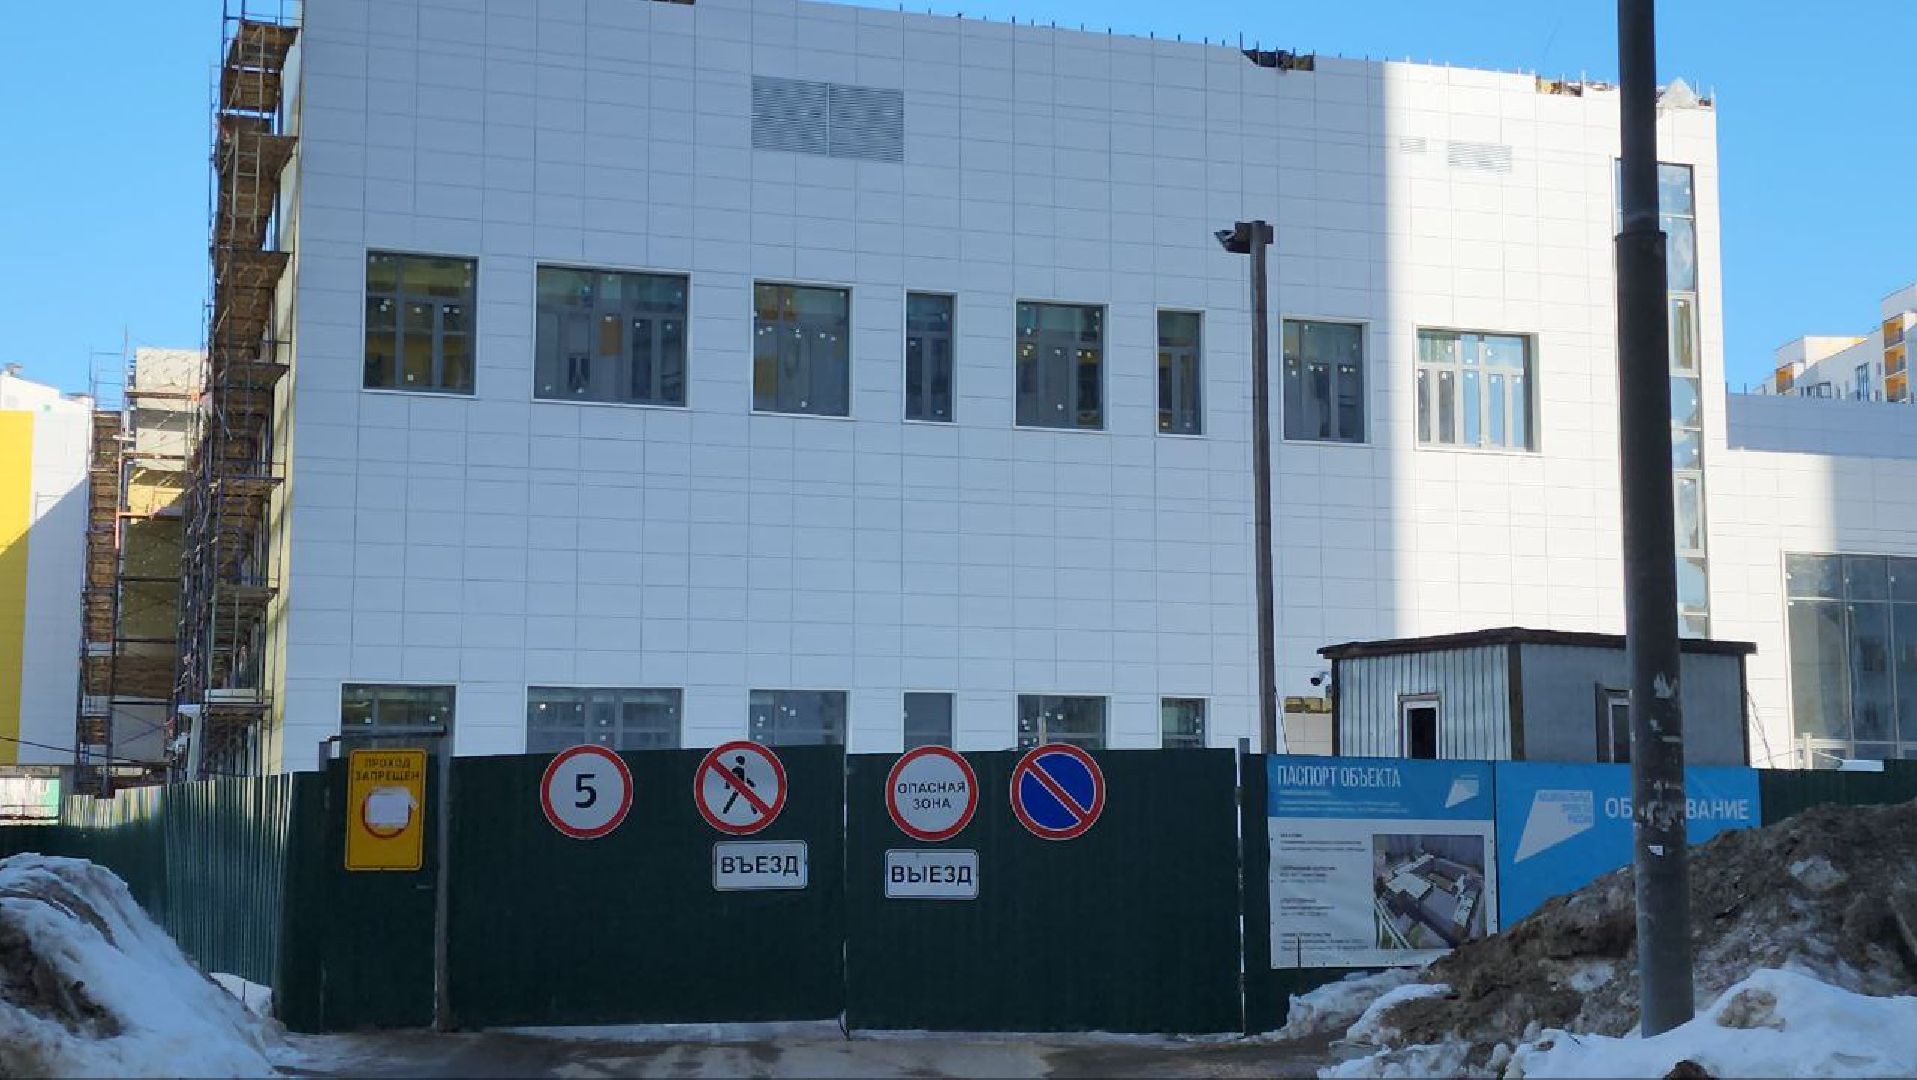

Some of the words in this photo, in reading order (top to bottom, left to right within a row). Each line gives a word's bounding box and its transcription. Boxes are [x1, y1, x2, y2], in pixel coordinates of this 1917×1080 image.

[364, 758, 411, 769] ПРОХОД
[354, 770, 421, 782] ЗАПРЕЩЕН
[1277, 765, 1336, 786] ПАСПОРТ
[1340, 767, 1402, 788] ОБЪЕКТА
[574, 773, 598, 809] 5
[897, 781, 967, 795] ОПАСНАЯ
[912, 797, 952, 810] ЗОНА
[1604, 797, 1750, 820] ОБВАНИЕ
[720, 855, 800, 877] ВЪЕЗД
[890, 866, 973, 887] ВЫЕЗД
